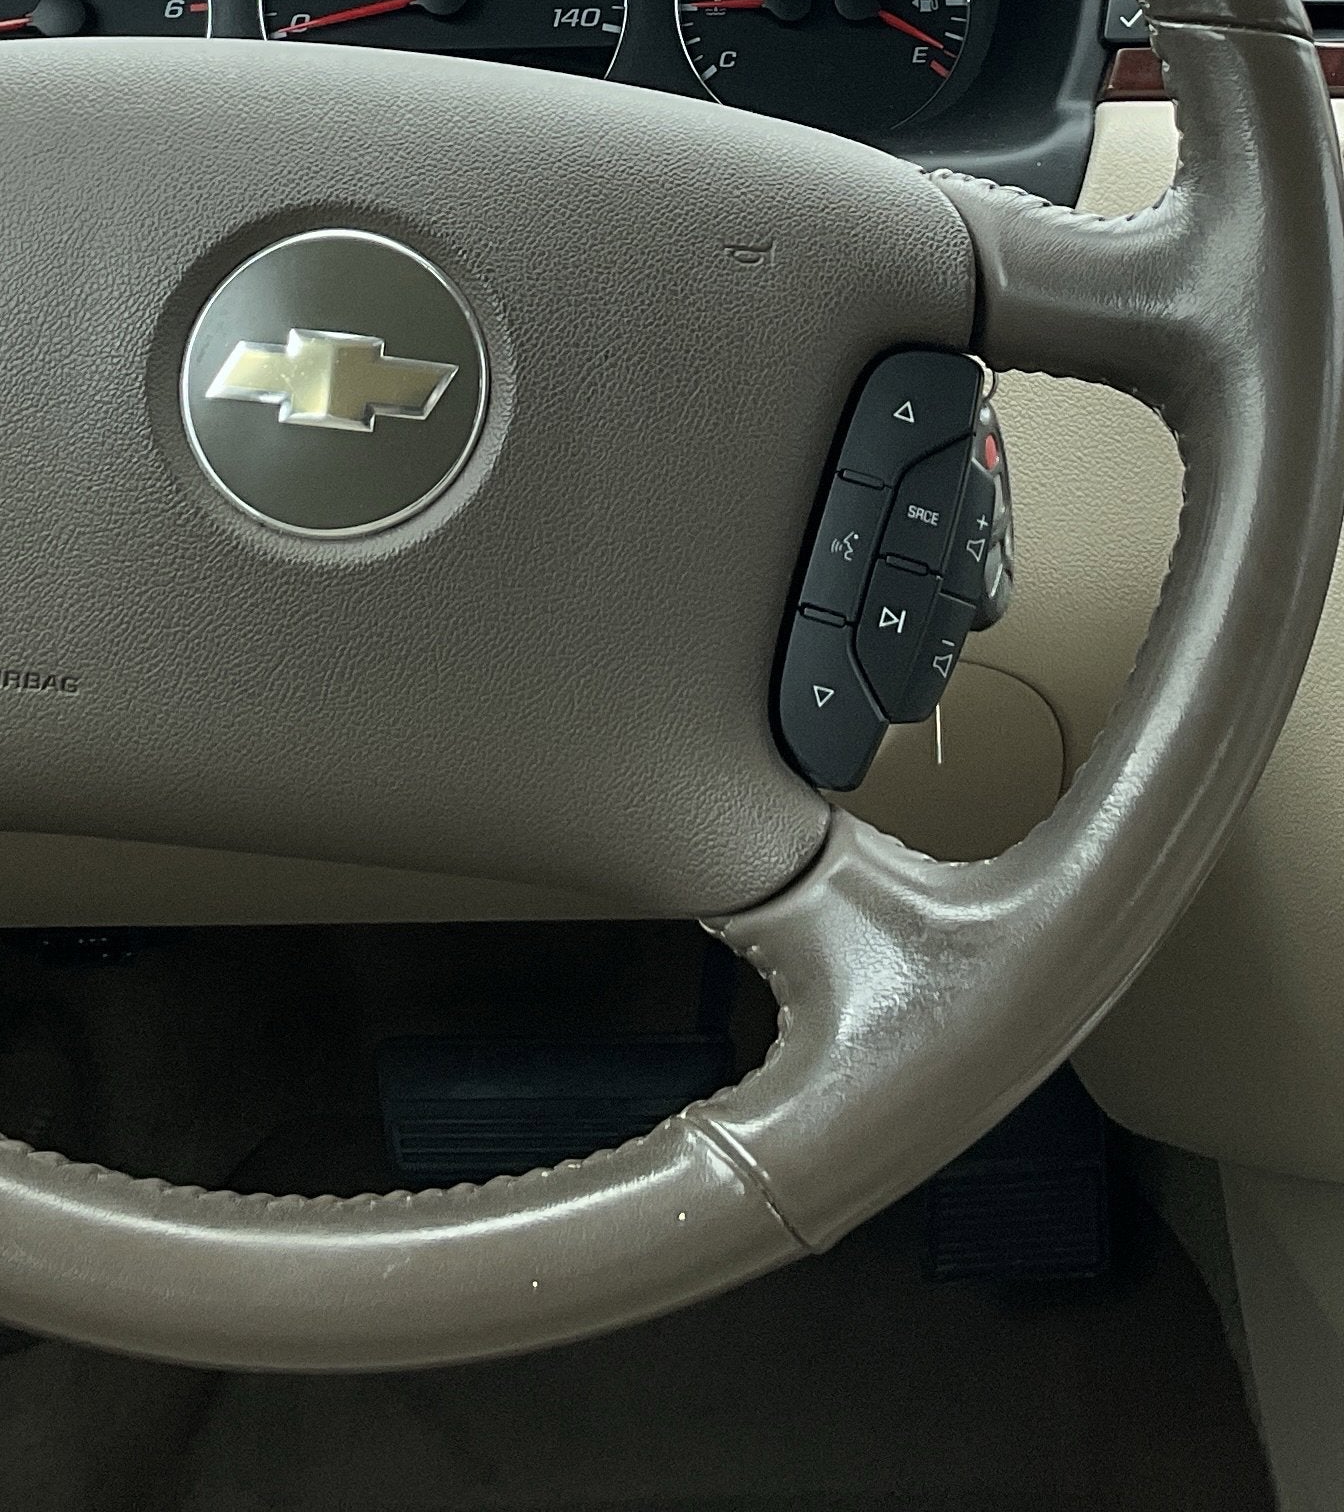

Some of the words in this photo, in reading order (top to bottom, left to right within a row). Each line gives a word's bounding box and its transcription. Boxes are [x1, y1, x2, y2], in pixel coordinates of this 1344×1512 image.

[164, 0, 185, 19] 6
[552, 7, 601, 28] 140
[290, 13, 311, 33] 0
[719, 51, 737, 68] C
[912, 46, 928, 64] E
[907, 504, 940, 527] SRCE
